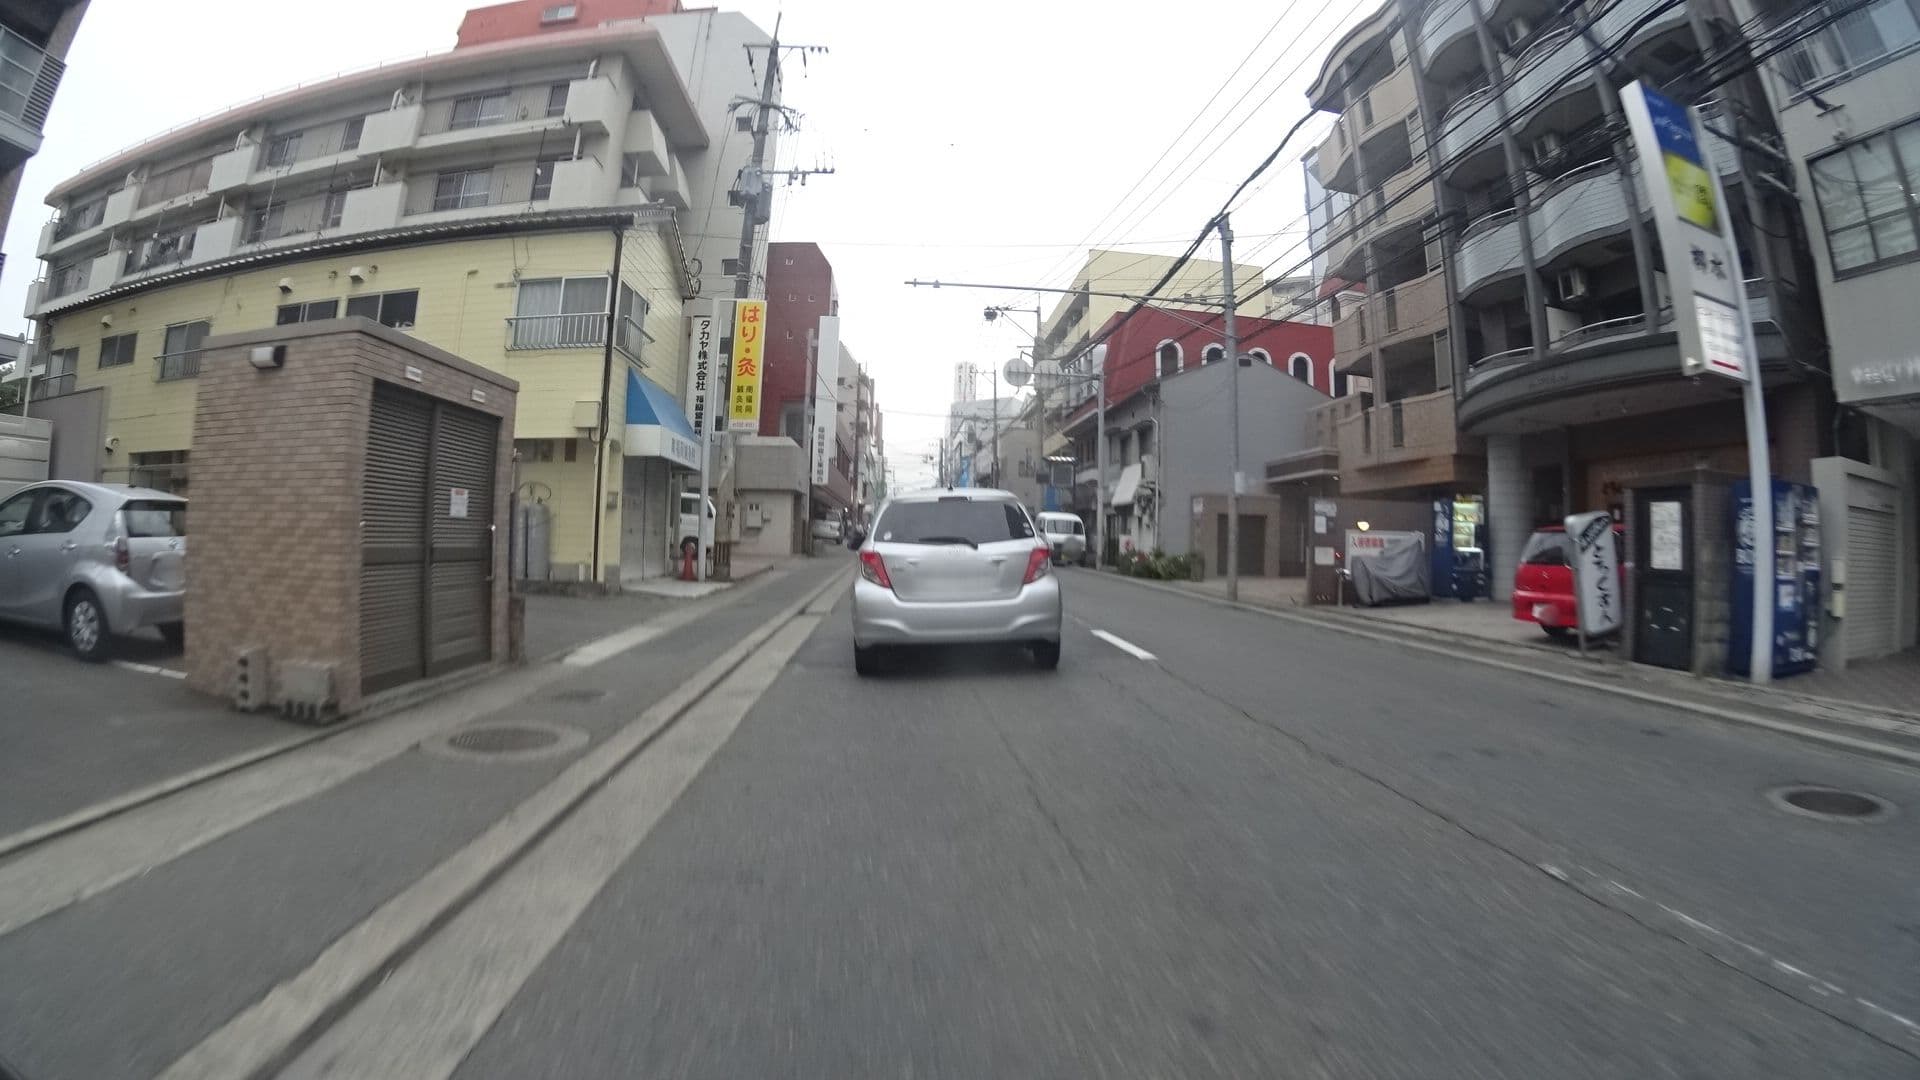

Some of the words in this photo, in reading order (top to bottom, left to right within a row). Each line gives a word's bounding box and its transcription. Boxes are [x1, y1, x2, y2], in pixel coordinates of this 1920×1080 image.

[696, 319, 711, 391] タカヤ株式会社
[737, 305, 760, 377] はり・灸
